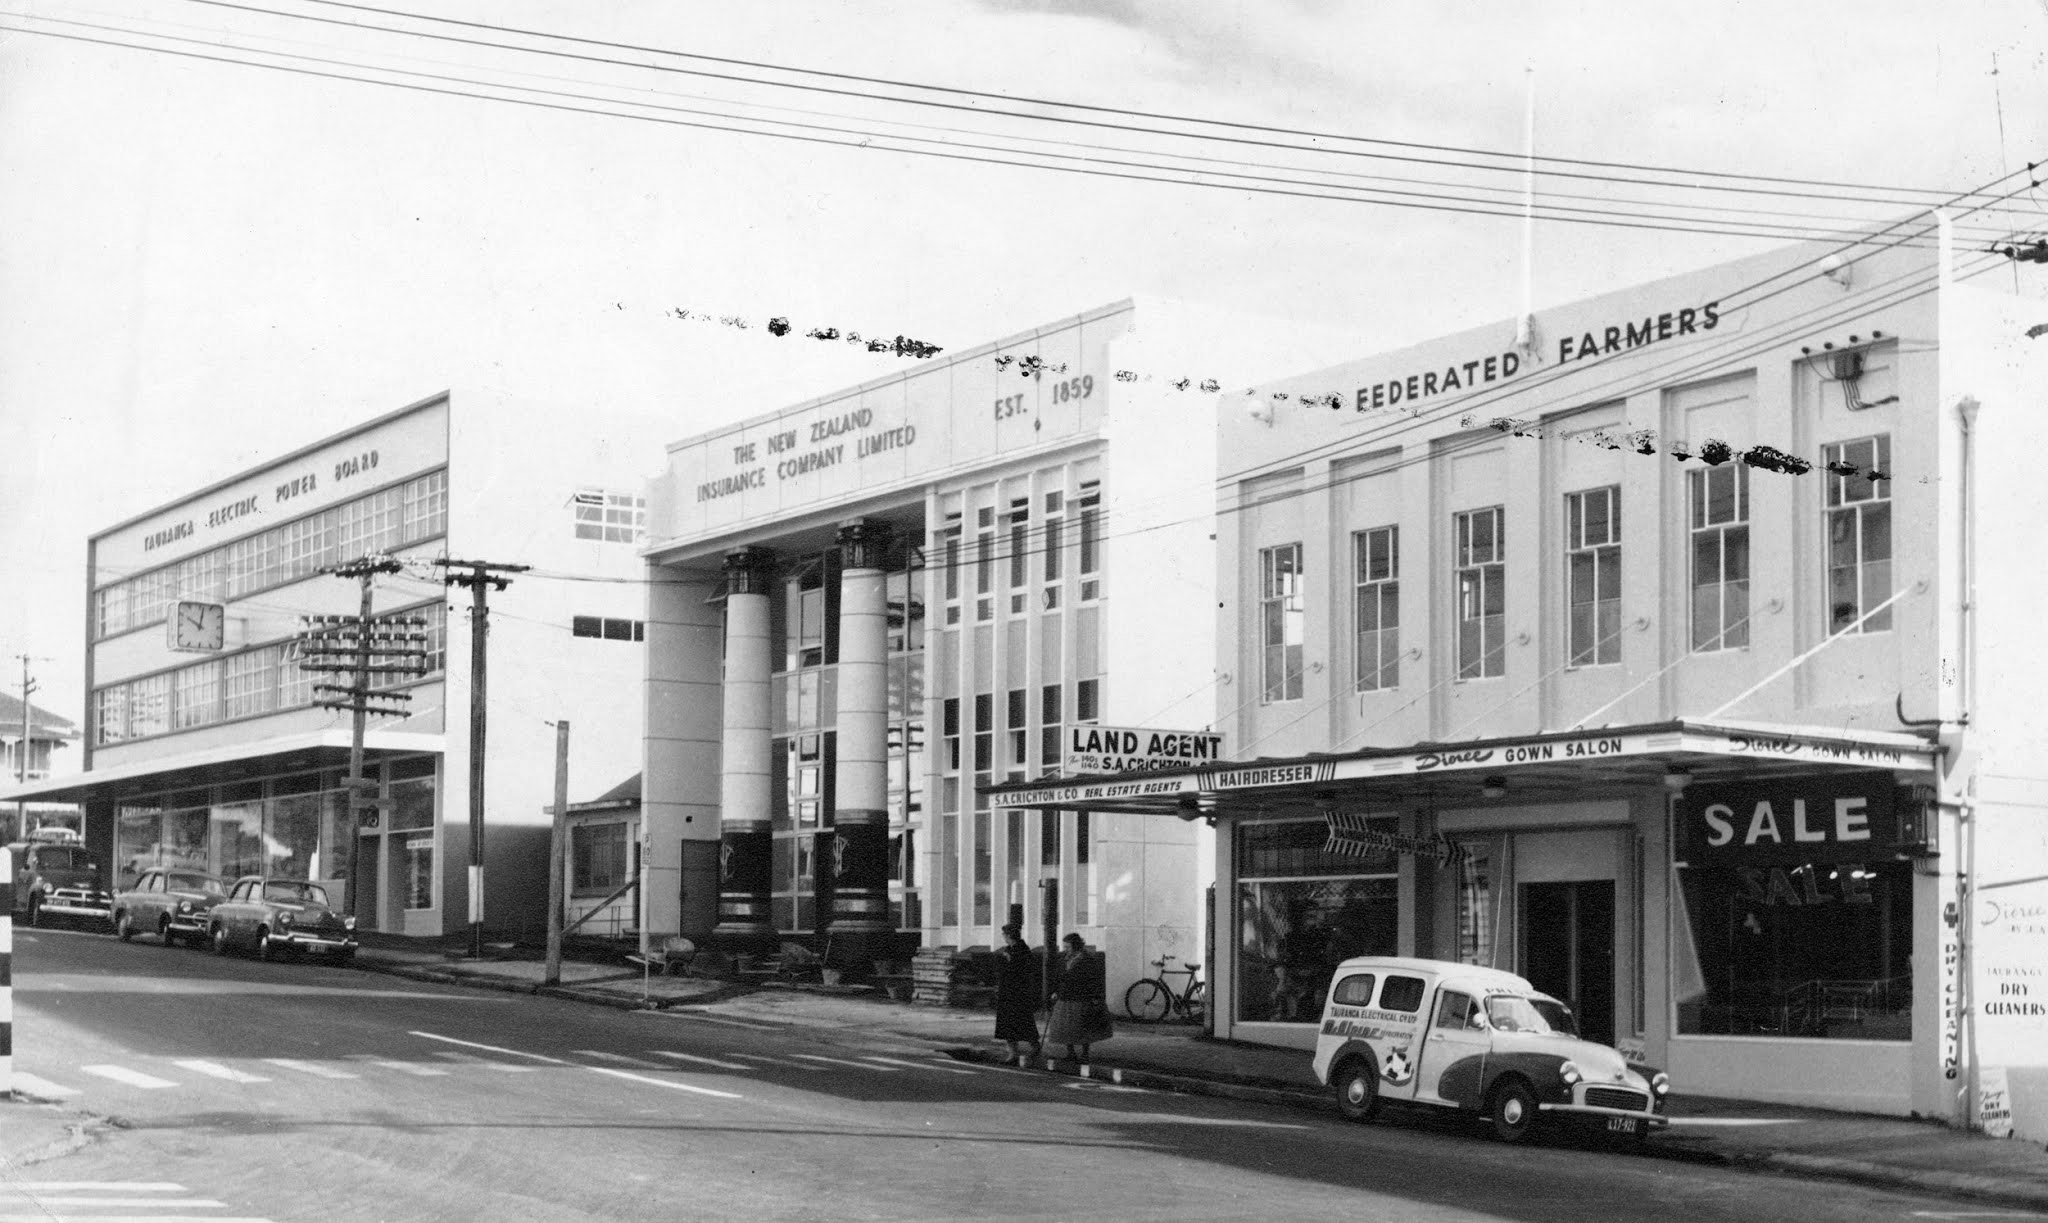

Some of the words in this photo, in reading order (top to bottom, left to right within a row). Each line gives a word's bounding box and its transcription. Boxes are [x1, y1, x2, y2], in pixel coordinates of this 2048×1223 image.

[1355, 352, 1520, 412] FEDERATED
[1559, 301, 1720, 364] FARMERS
[995, 393, 1027, 421] EST.
[1053, 374, 1093, 405] 1859
[733, 442, 757, 465] THE
[768, 429, 797, 455] NEW
[810, 408, 873, 443] ZEALAND
[697, 467, 766, 503] INSURANCE
[777, 444, 844, 480] COMPANY
[857, 425, 916, 459] LIMITED
[144, 520, 194, 552] TAURANGA
[208, 495, 259, 528] ELECTRIC
[276, 473, 317, 503] POWER
[334, 449, 380, 482] BOARD
[1073, 729, 1138, 755] LAND
[1147, 733, 1222, 759] AGENT
[1505, 745, 1553, 762] GOWN
[1566, 738, 1622, 757] SALON
[1812, 746, 1851, 760] GOWN
[1859, 750, 1901, 764] SALON
[1085, 786, 1104, 799] REAL
[1107, 783, 1141, 797] ESTATE
[1143, 780, 1182, 793] AGENTS
[1220, 766, 1312, 787] HAIRDRESSER
[1704, 797, 1871, 847] SALE
[2001, 983, 2029, 996] DRY
[1330, 1007, 1360, 1019] TAURANGA
[1361, 1009, 1398, 1022] ELECTRICAL
[1985, 1002, 2046, 1016] CLEANERS
